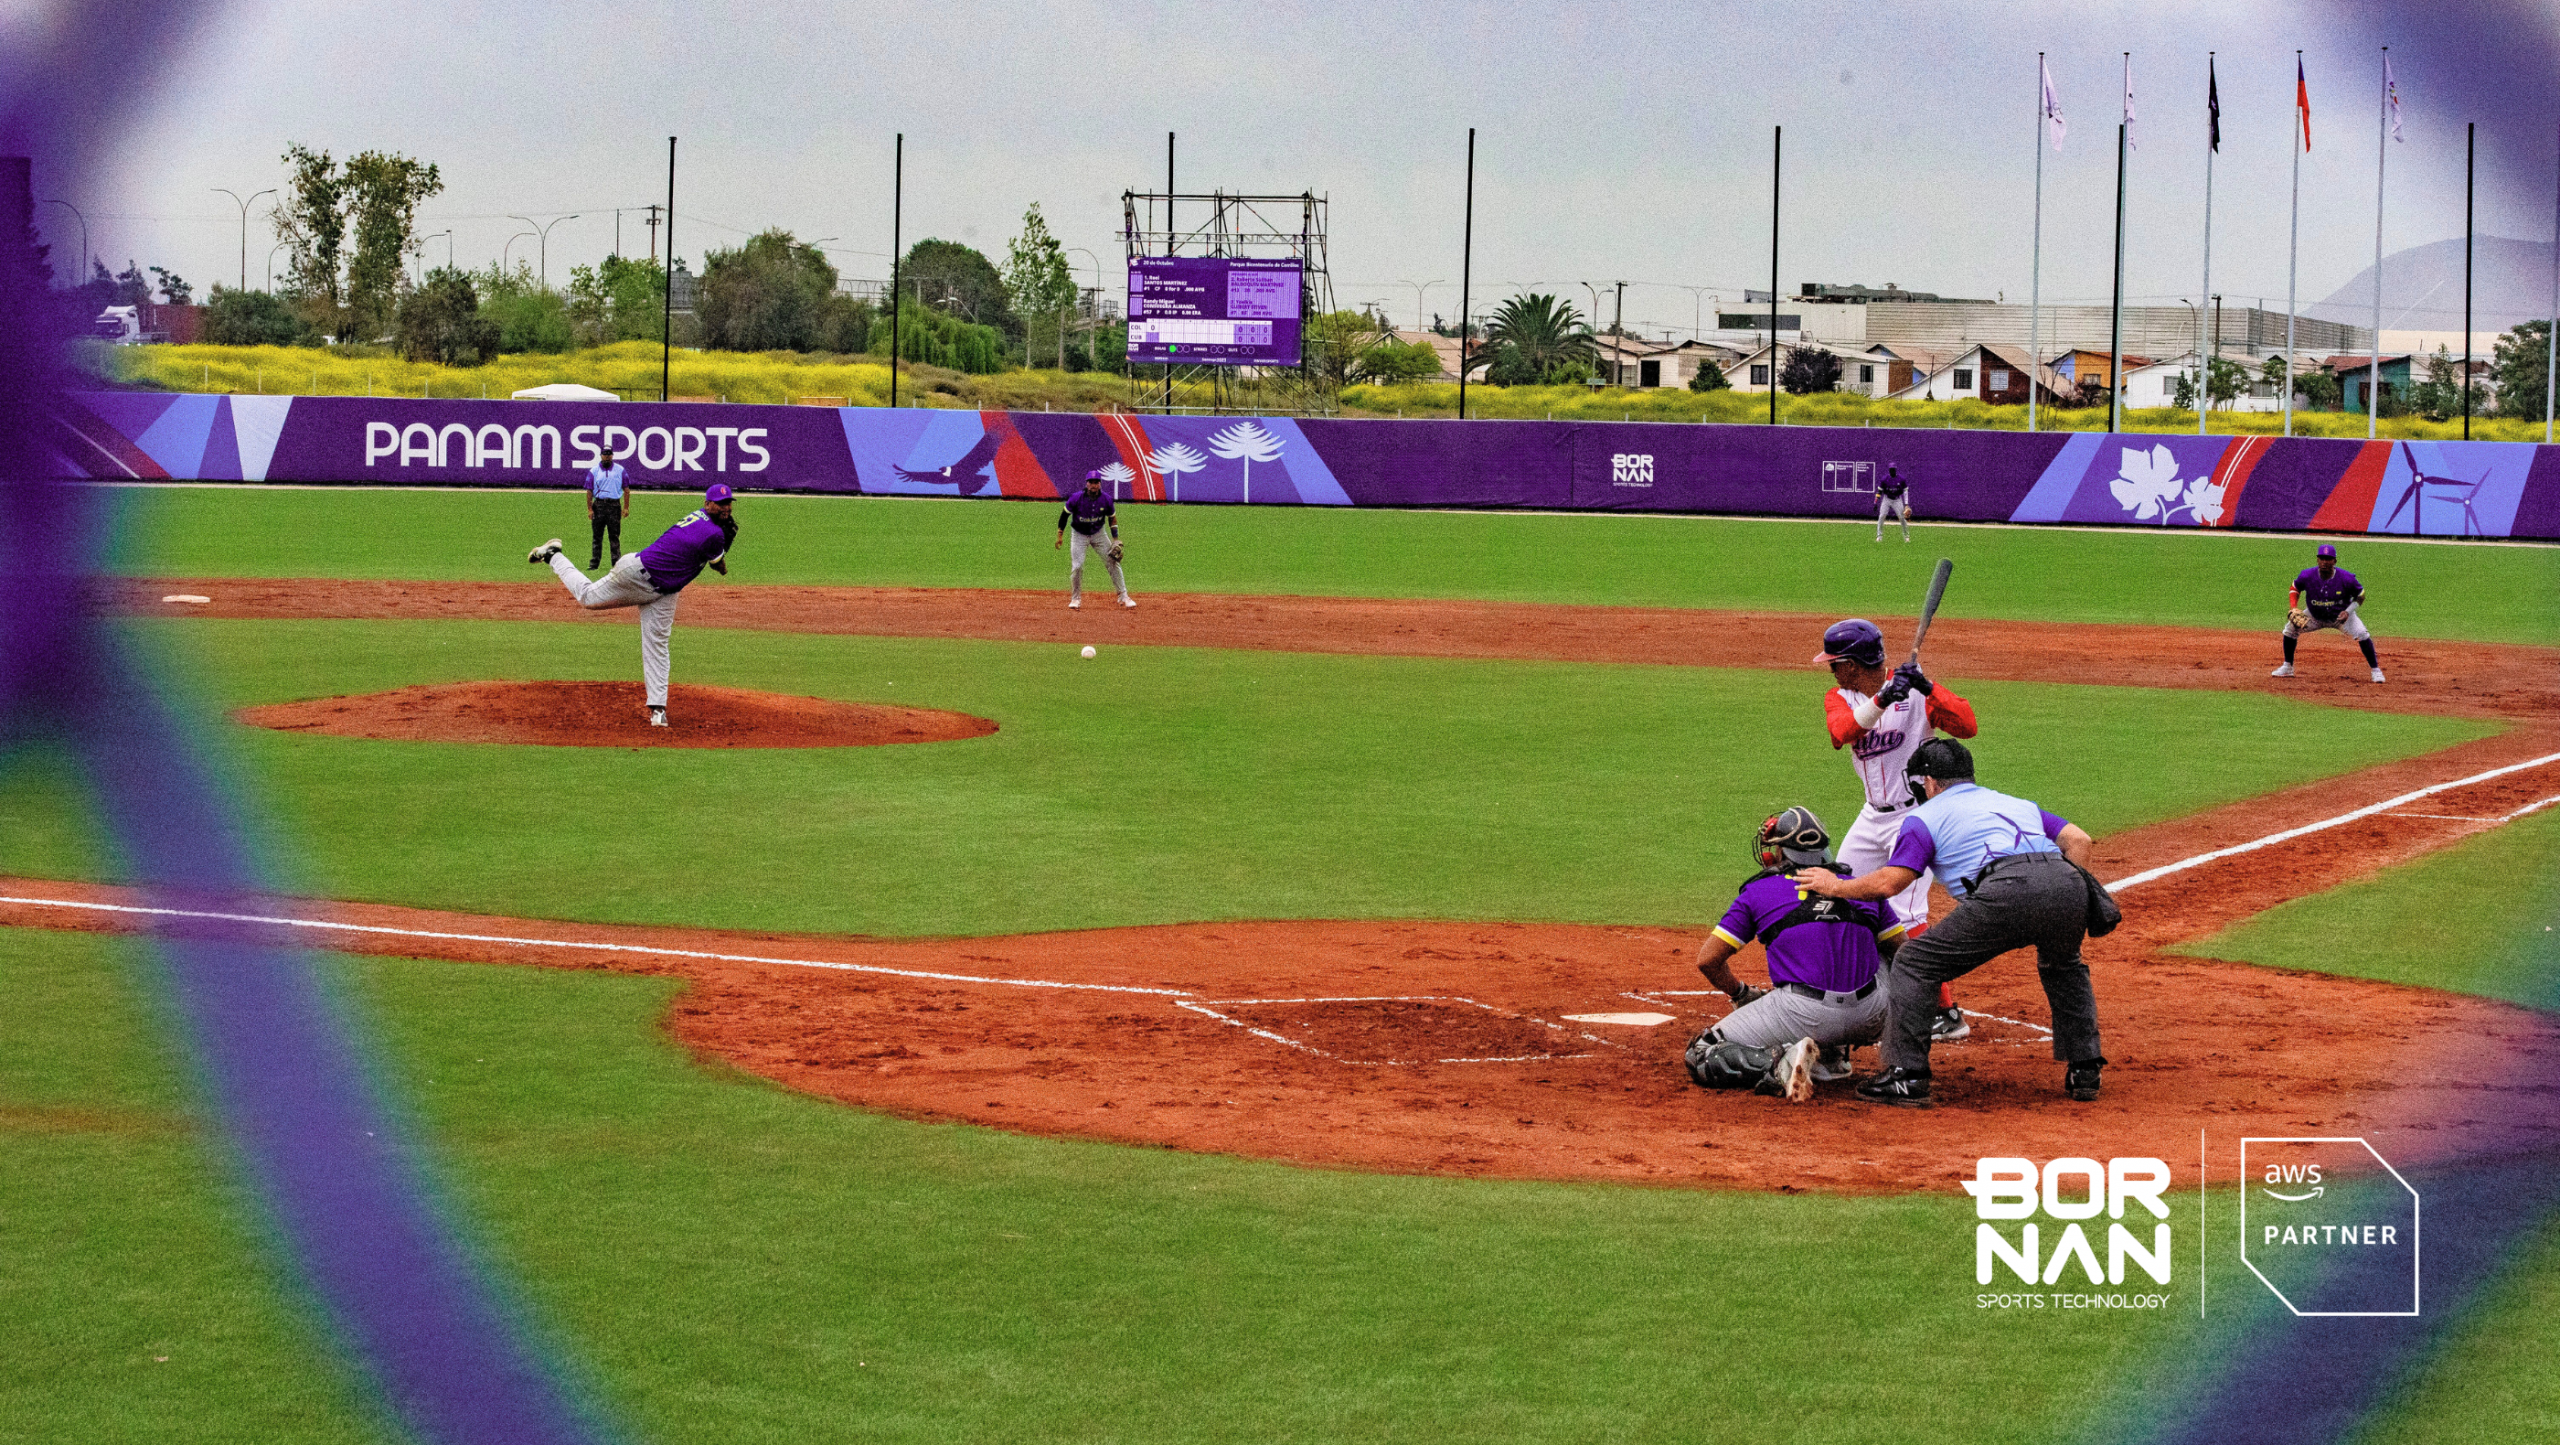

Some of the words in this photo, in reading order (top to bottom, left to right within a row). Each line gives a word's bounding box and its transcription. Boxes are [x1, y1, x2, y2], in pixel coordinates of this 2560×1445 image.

[366, 422, 560, 468] PANAM
[570, 425, 770, 472] SPORTS
[1610, 454, 1653, 468] BOR
[1613, 468, 1653, 482] NAN
[1852, 728, 1905, 756] uba
